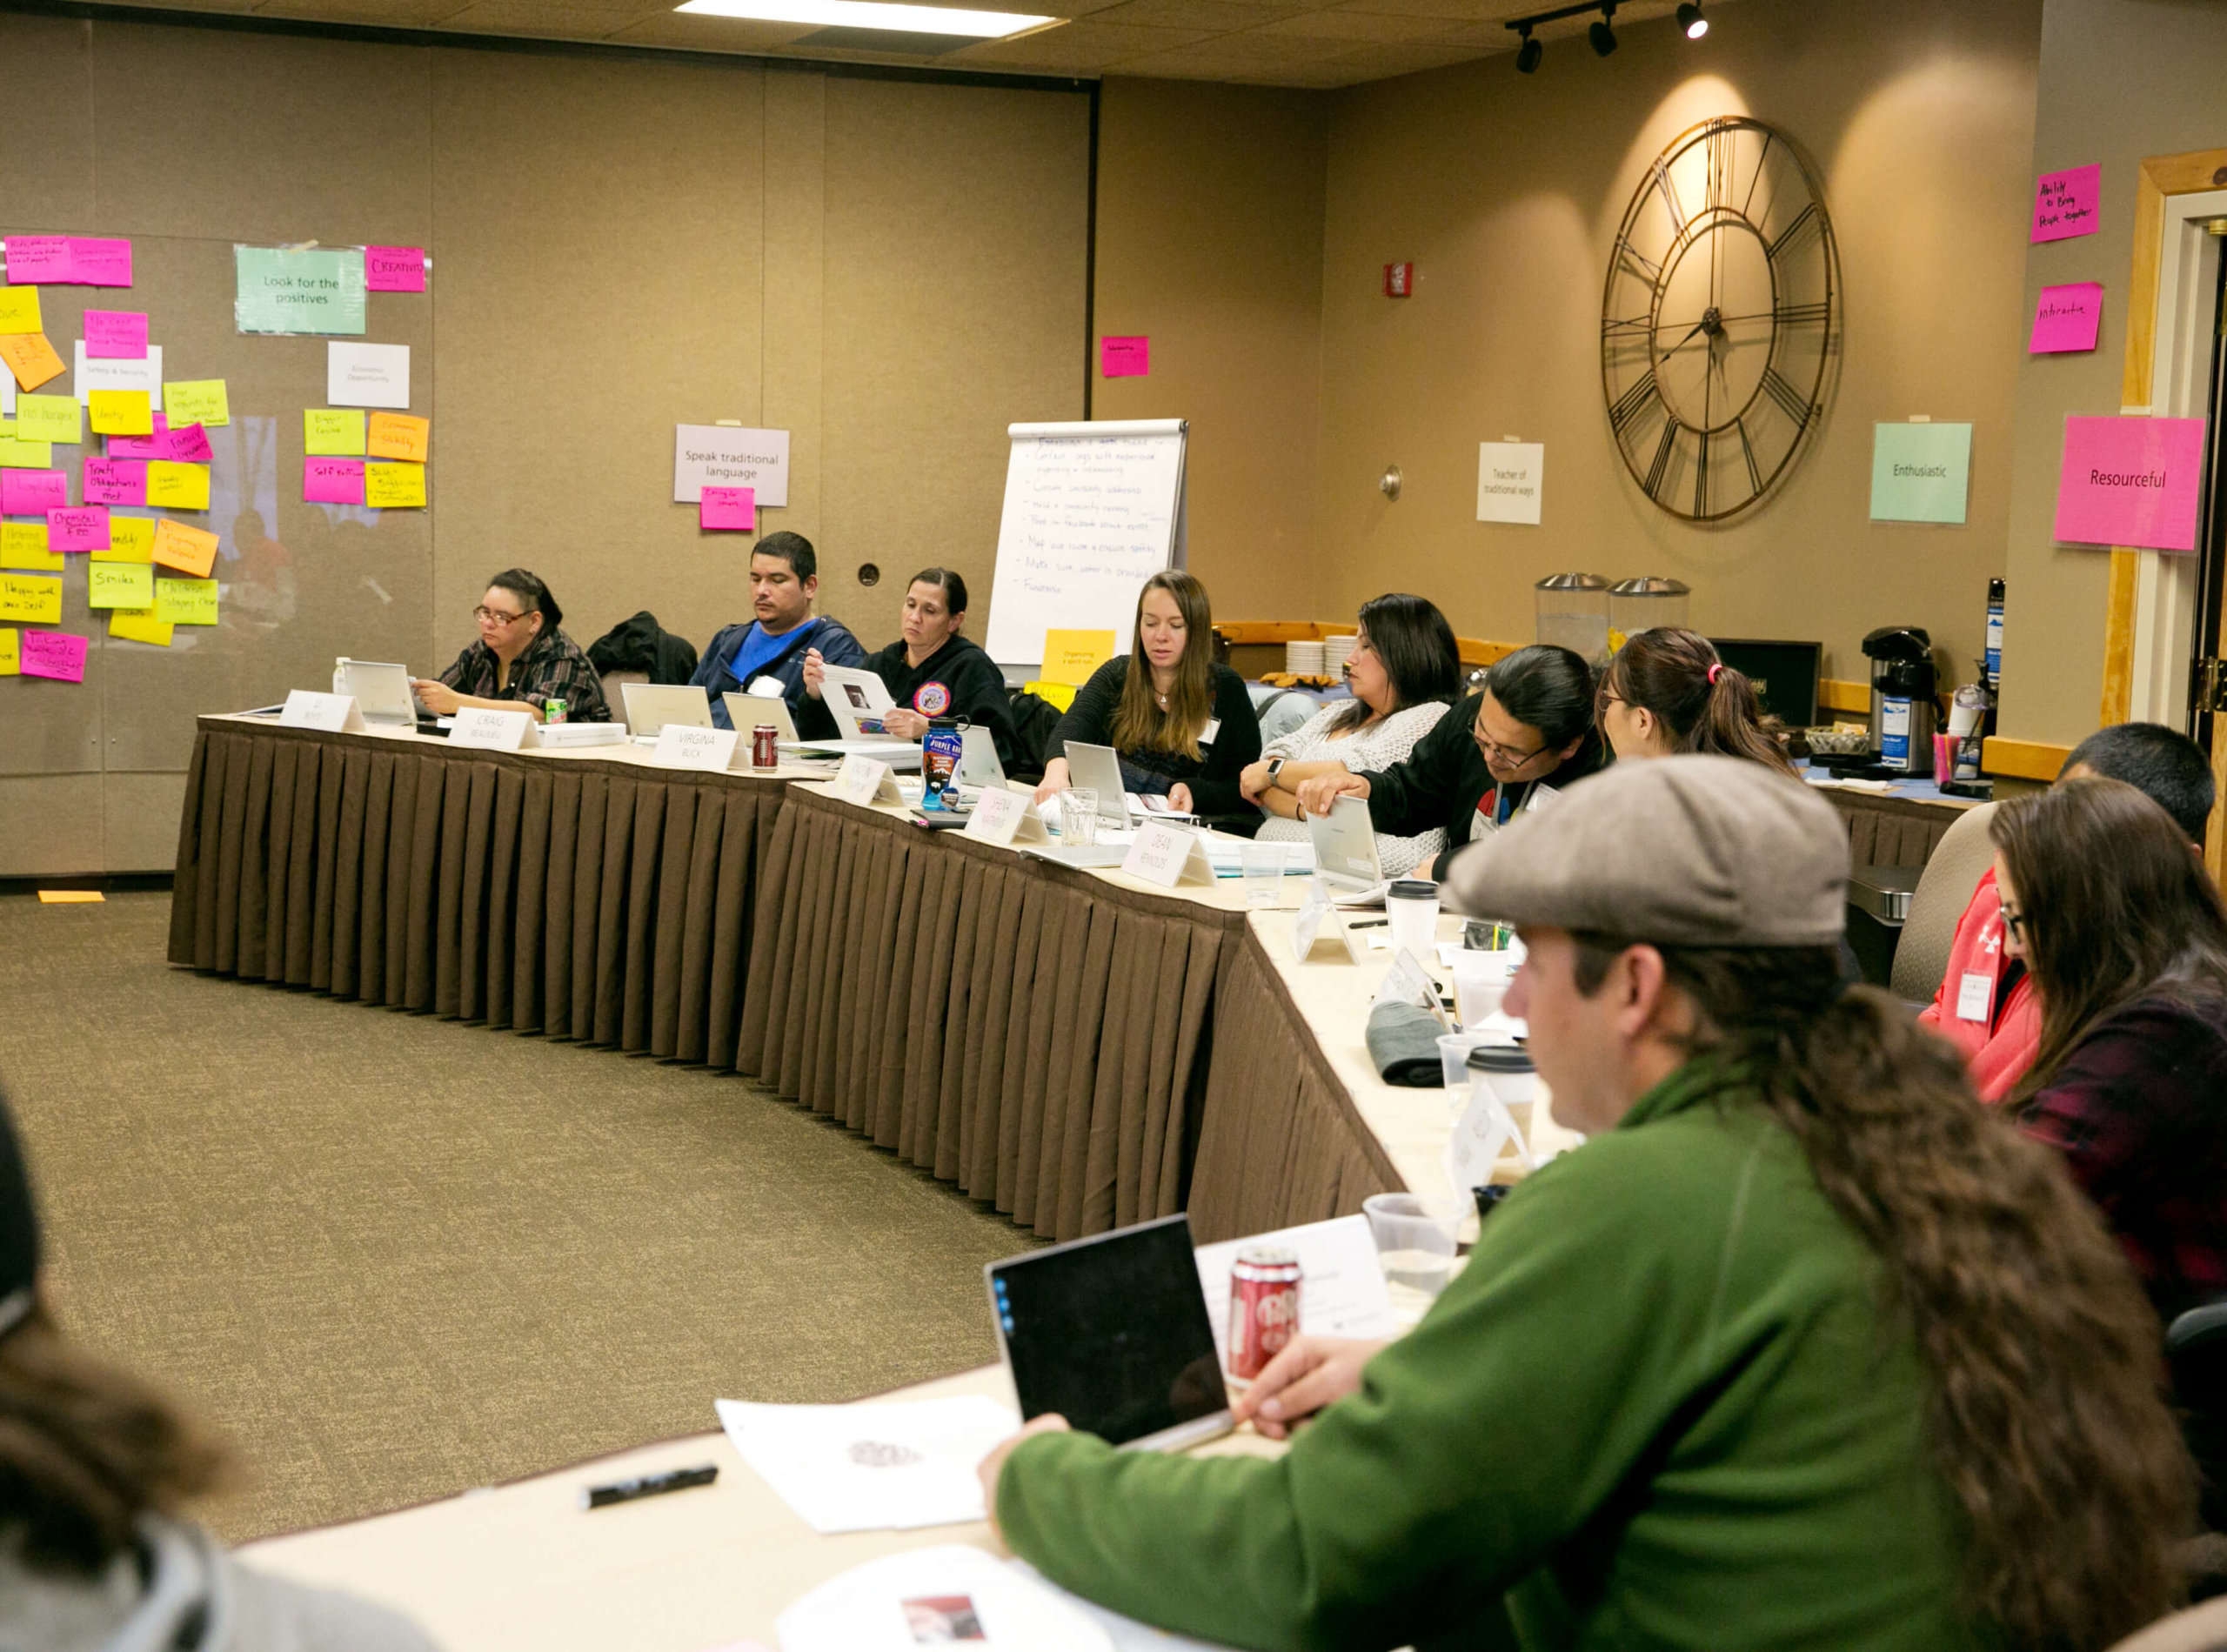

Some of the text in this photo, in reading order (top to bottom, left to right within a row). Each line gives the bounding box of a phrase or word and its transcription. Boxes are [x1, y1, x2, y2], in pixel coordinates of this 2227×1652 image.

[264, 276, 339, 290] Look for the
[276, 292, 329, 304] positives
[685, 451, 779, 465] Speak traditional
[706, 465, 758, 479] language
[1494, 469, 1527, 479] Teacher of
[1893, 464, 1946, 478] Enthusiastic
[2090, 469, 2166, 488] Resourceful
[1484, 485, 1517, 494] traditional
[478, 715, 505, 727] CRAIG
[930, 739, 951, 752] PURPLE
